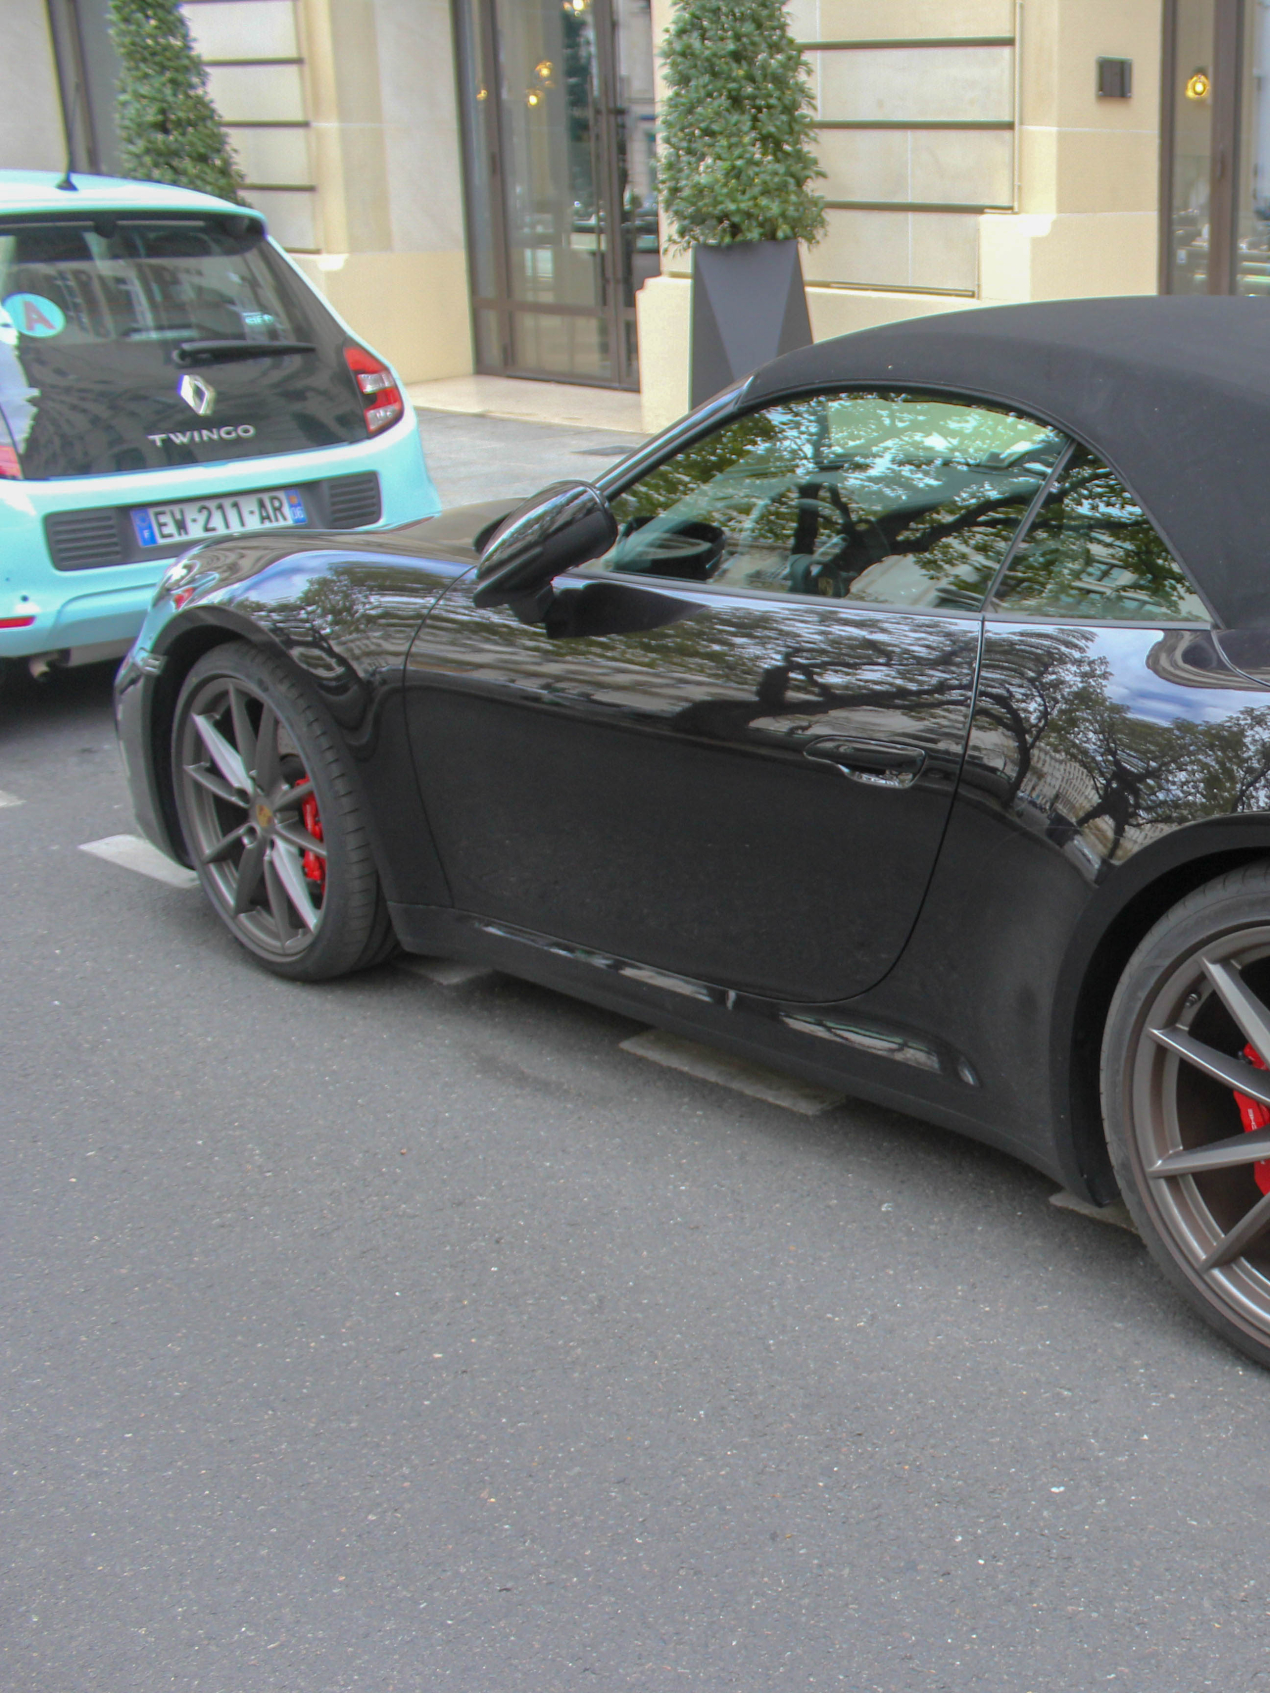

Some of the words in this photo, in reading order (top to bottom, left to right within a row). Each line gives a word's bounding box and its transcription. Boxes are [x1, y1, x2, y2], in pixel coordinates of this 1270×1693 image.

[22, 300, 56, 332] A
[147, 424, 256, 447] TWINGO
[152, 494, 288, 540] EW-211-AR
[143, 529, 151, 540] F
